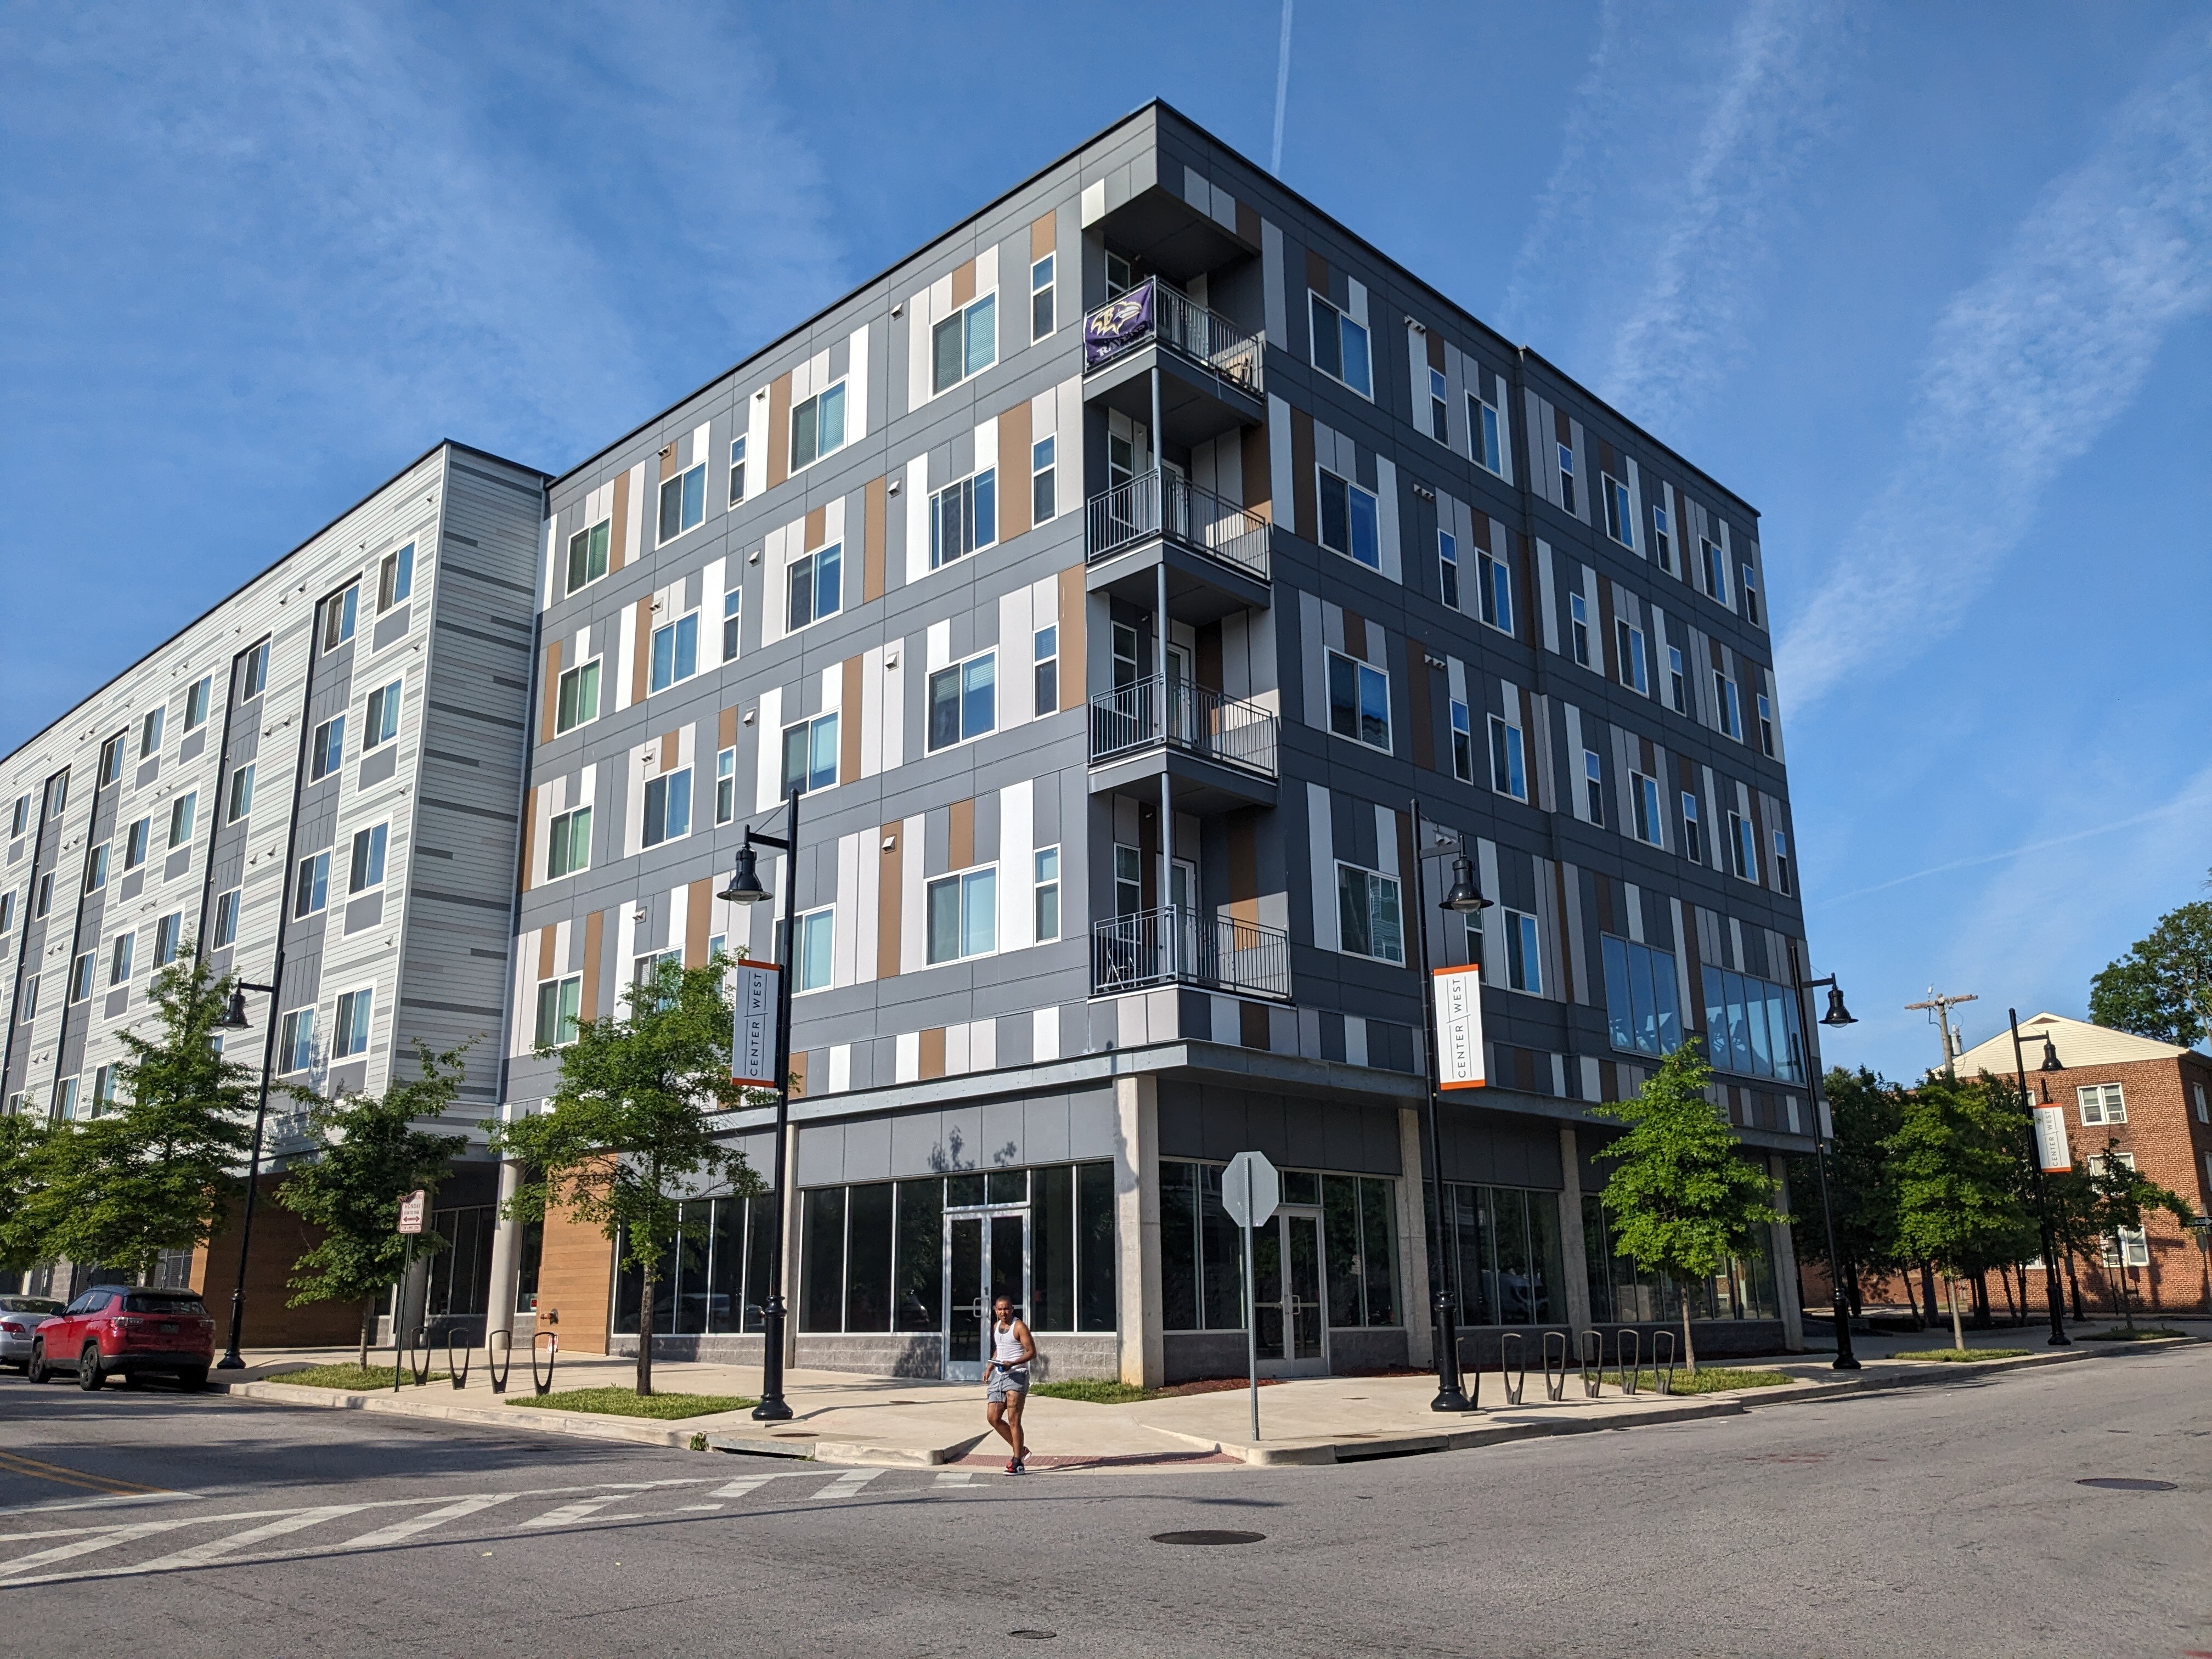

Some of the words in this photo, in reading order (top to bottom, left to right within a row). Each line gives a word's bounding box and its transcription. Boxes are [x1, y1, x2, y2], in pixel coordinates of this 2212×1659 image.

[753, 973, 762, 1008] WEST
[1452, 979, 1462, 1013] WEST
[750, 1022, 760, 1076] CENTER
[1455, 1025, 1466, 1078] CENTER
[2045, 1111, 2053, 1131] WEST
[2049, 1137, 2058, 1166] CENTER
